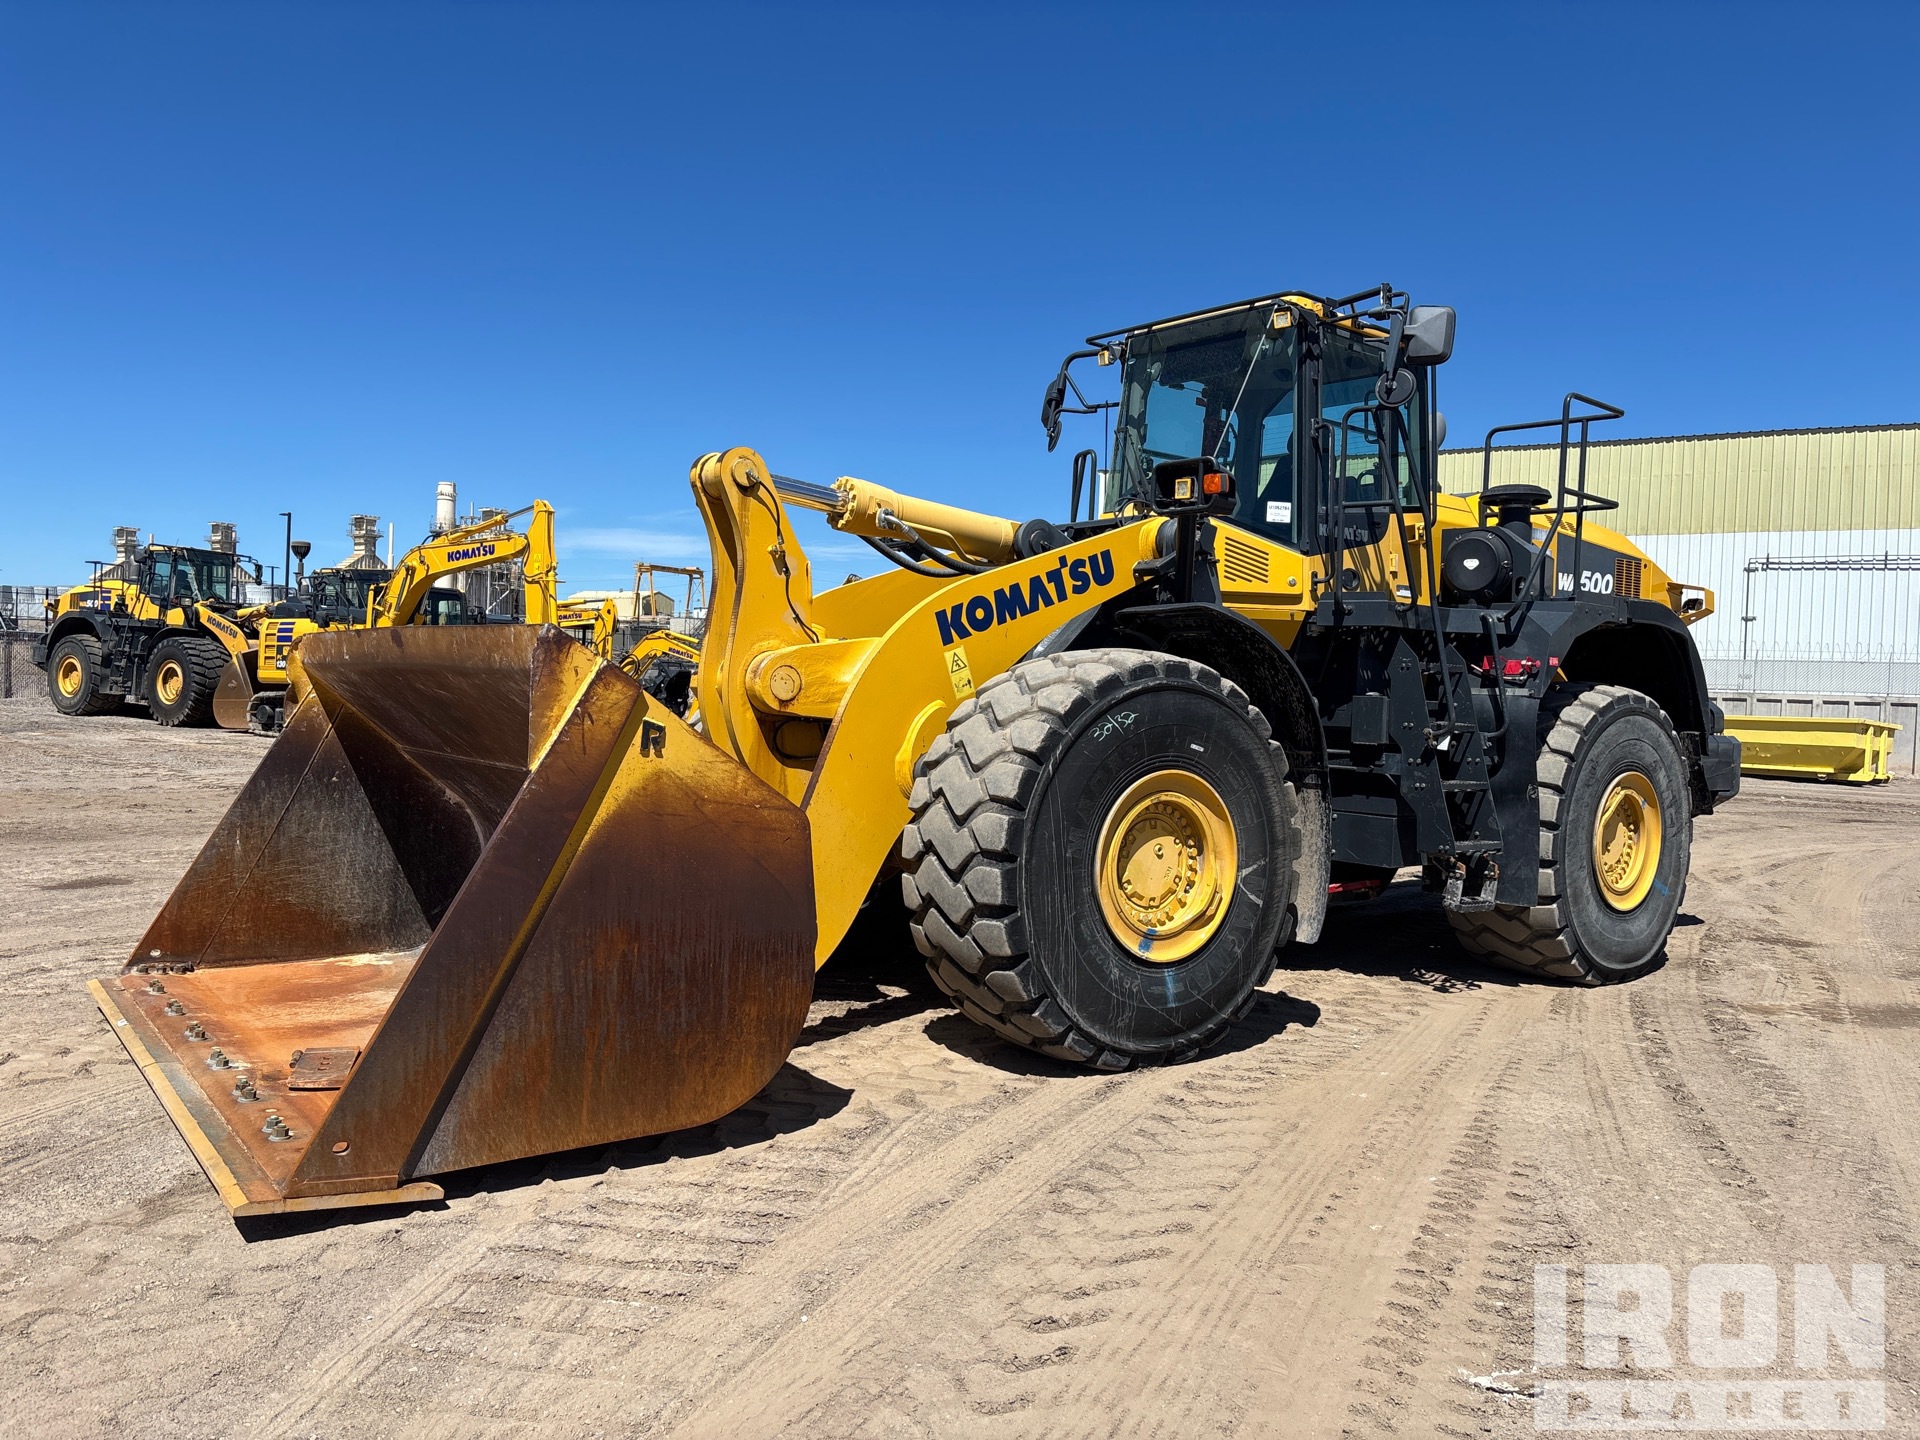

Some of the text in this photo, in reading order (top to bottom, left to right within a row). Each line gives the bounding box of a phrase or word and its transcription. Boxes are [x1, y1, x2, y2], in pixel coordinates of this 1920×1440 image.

[1319, 523, 1369, 543] KATSU
[447, 542, 495, 563] KOMATSU
[935, 549, 1115, 647] KOMATSU
[207, 614, 238, 639] KOMATSU
[559, 612, 583, 621] OMATSU
[668, 646, 694, 660] KOMATSU
[640, 717, 667, 758] R
[1088, 711, 1140, 742] 32/32
